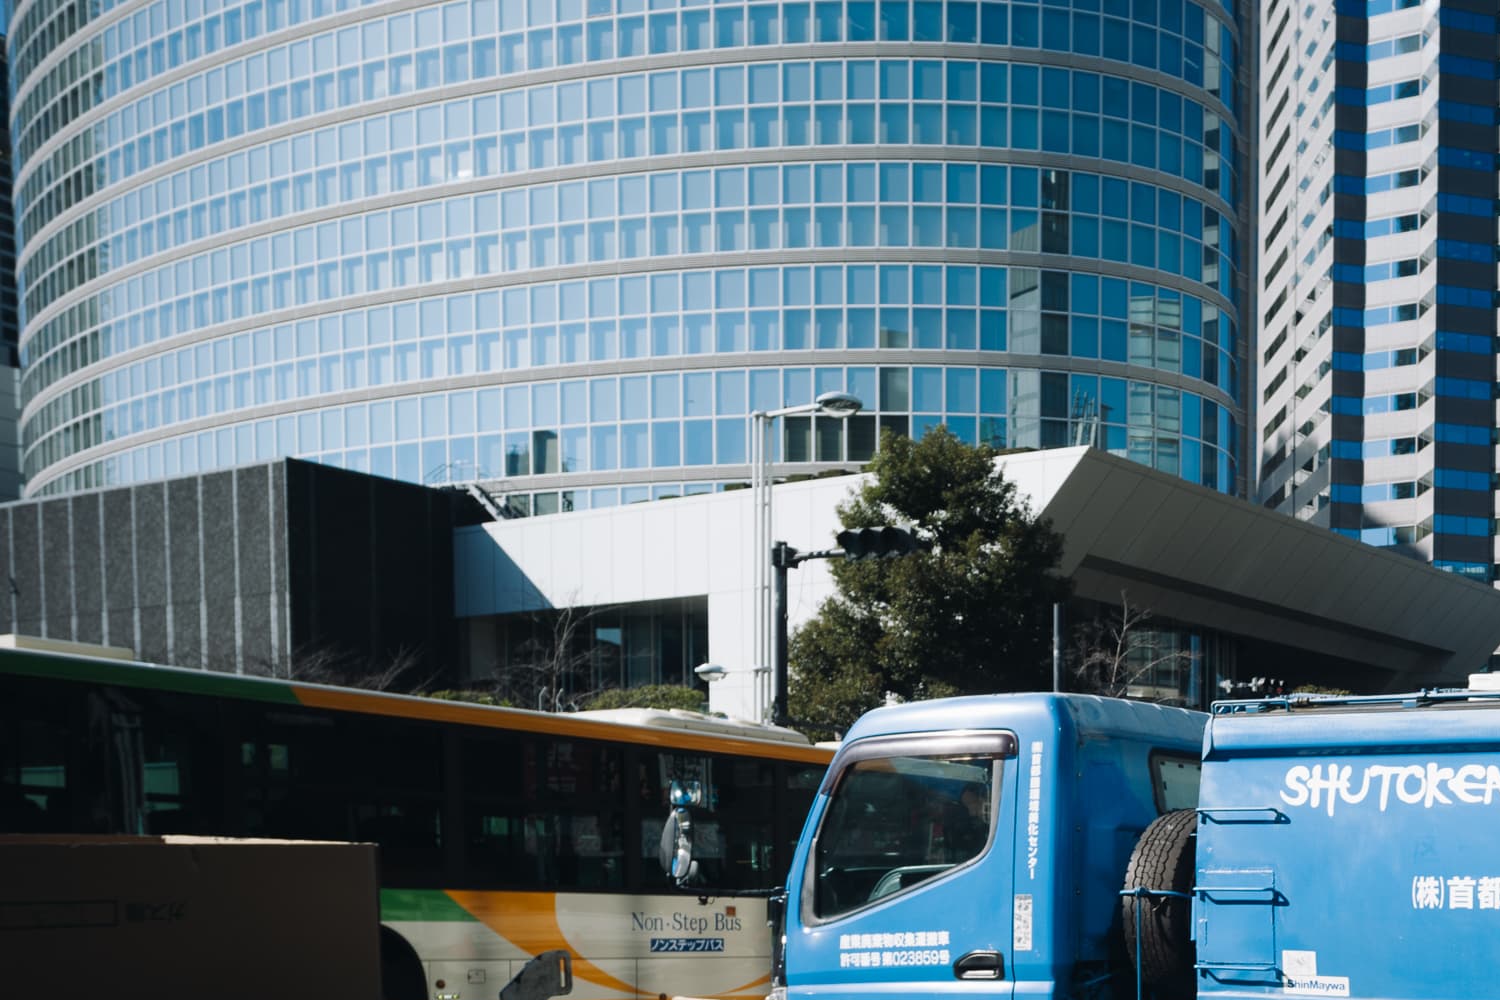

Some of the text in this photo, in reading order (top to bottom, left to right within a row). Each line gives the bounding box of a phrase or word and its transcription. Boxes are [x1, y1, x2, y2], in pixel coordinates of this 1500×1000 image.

[714, 912, 742, 931] Bus
[651, 938, 724, 951] ノンステップバス
[1287, 979, 1346, 992] ShinMaywa
